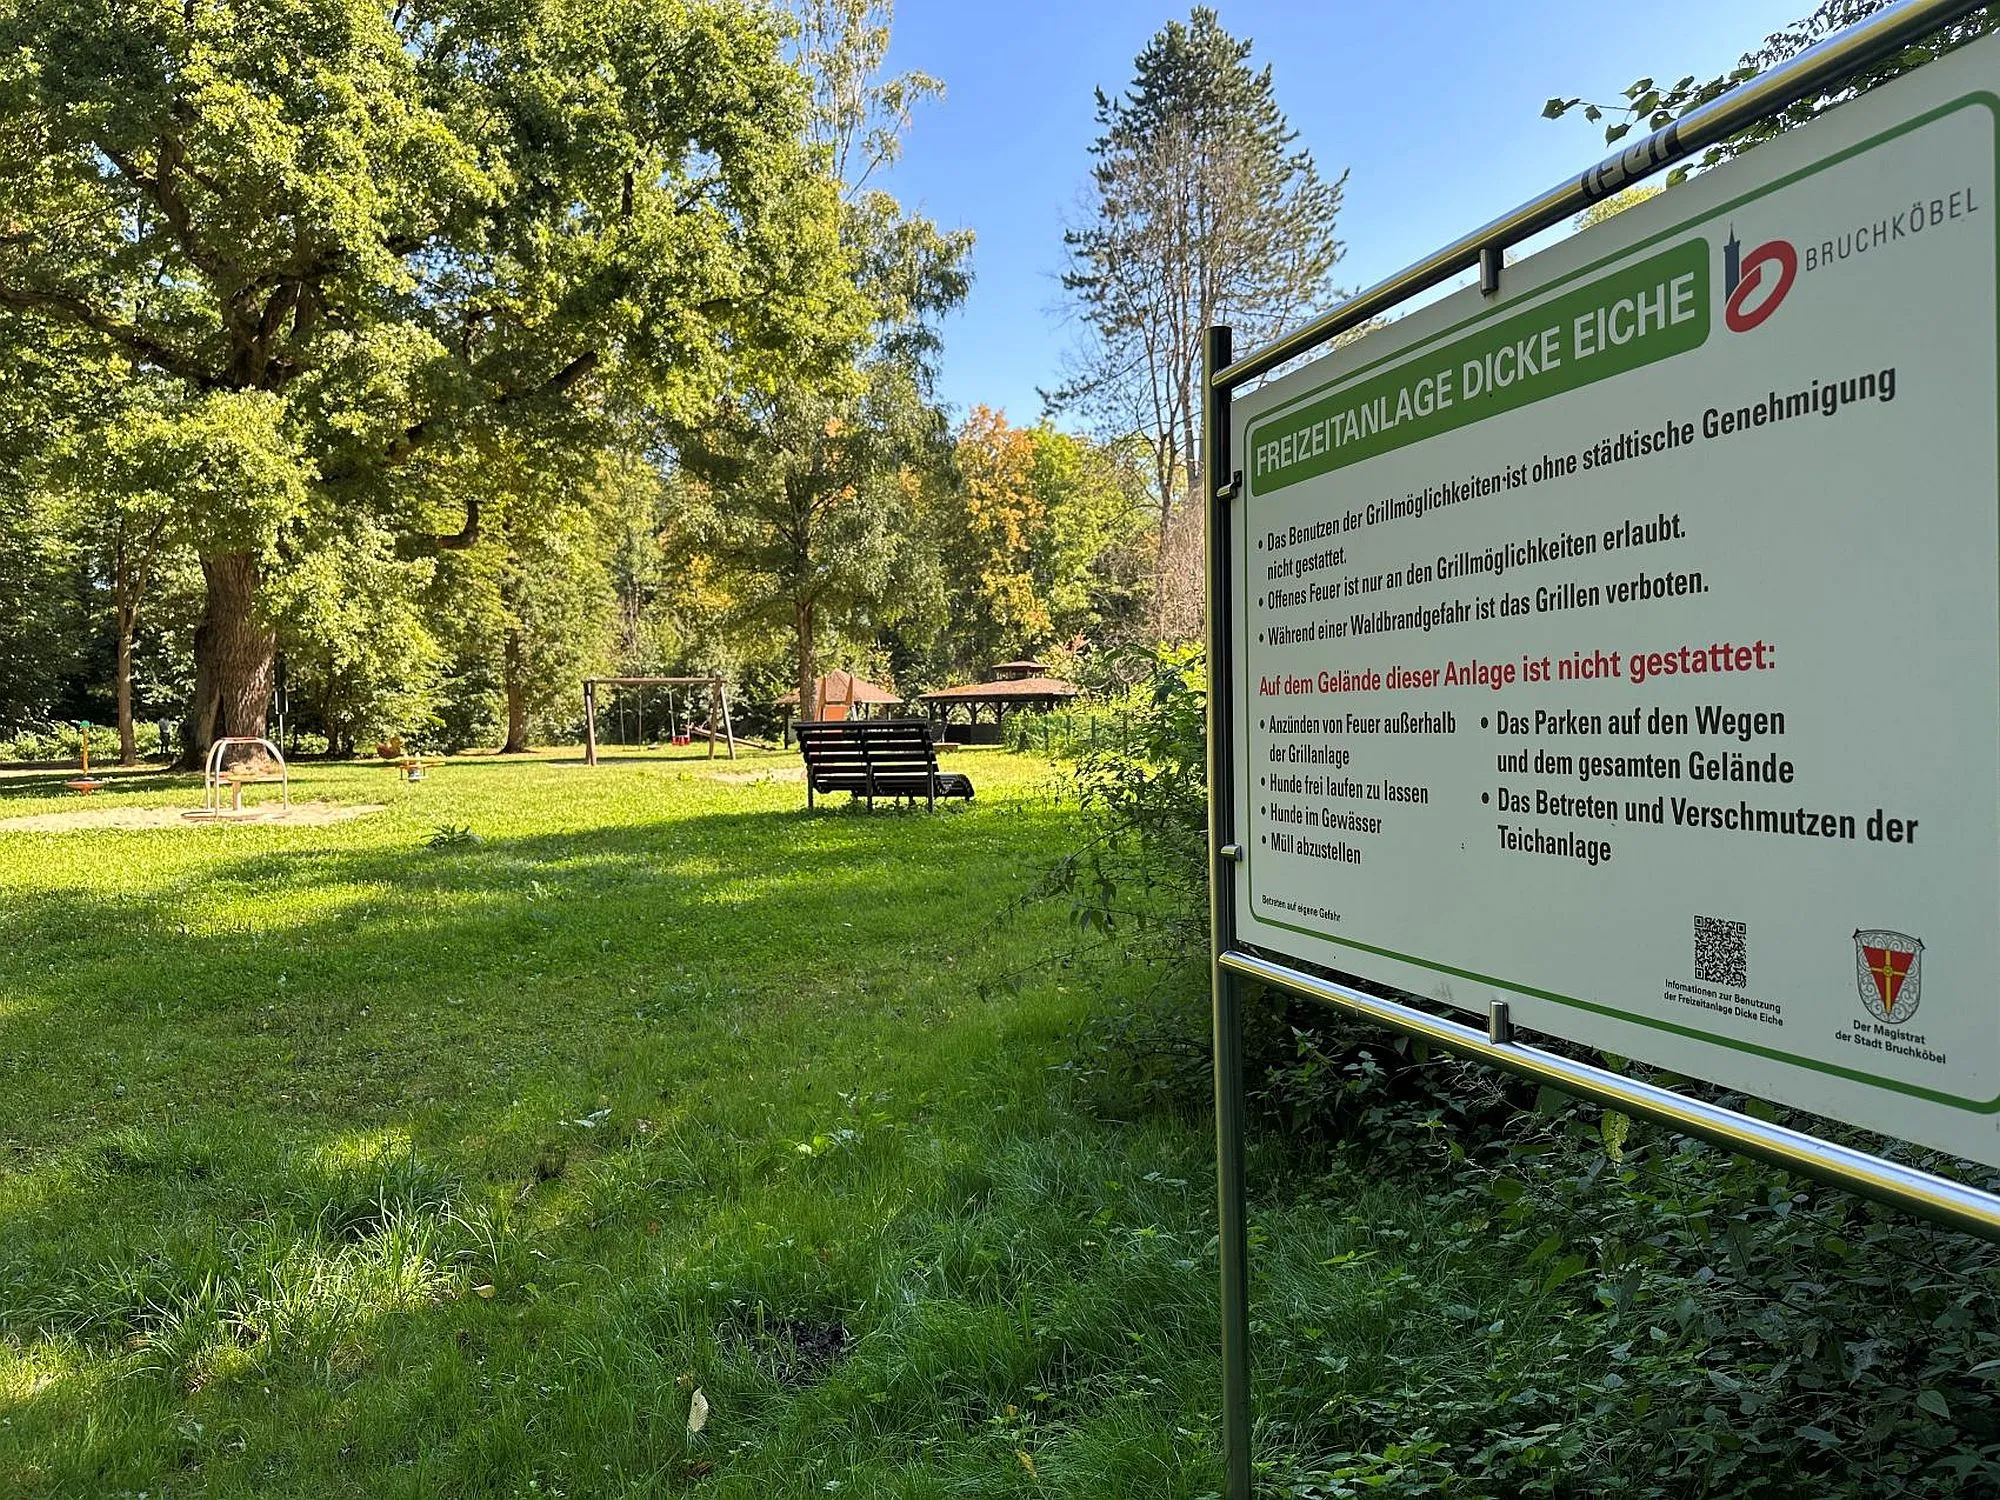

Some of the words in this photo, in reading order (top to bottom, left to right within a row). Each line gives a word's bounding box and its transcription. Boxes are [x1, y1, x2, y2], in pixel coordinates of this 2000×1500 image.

[1807, 188, 1978, 271] BRUCHKÖBEL
[1258, 369, 1452, 476] FREIZEITANLAGE
[1464, 326, 1560, 400] DICKE
[1574, 272, 1694, 359] EICHE
[1268, 533, 1286, 551] Das
[1289, 520, 1339, 546] Benutzen
[1343, 510, 1363, 532] der
[1367, 474, 1501, 526] Grillmöglichkeiten
[1505, 466, 1527, 488] ist
[1533, 455, 1577, 483] ohne
[1583, 420, 1694, 470] städtische
[1703, 368, 1895, 439] Genehmigung
[1268, 589, 1306, 609] Offenes
[1310, 583, 1340, 602] Feuer
[1344, 576, 1359, 596] ist
[1362, 575, 1383, 593] nur
[1387, 571, 1402, 588] an
[1407, 563, 1432, 585] den
[1437, 533, 1596, 579] Grillmöglichkeiten
[1603, 514, 1685, 551] erlaubt.
[1268, 558, 1293, 580] nicht
[1296, 547, 1346, 578] gestattet.
[1268, 621, 1314, 646] Während
[1318, 619, 1347, 640] einer
[1350, 600, 1471, 635] Waldbrandgefahr
[1476, 597, 1495, 620] ist
[1500, 593, 1530, 617] das
[1536, 583, 1599, 612] Grillen
[1606, 572, 1708, 604] verboten.
[1260, 675, 1280, 696] Auf
[1284, 674, 1313, 695] dem
[1318, 668, 1380, 693] Gelände
[1386, 666, 1440, 689] dieser
[1444, 659, 1515, 690] Anlage
[1523, 655, 1550, 682] ist
[1559, 650, 1621, 680] nicht
[1630, 640, 1775, 684] gestattet:
[1269, 715, 1319, 733] Anzünden
[1322, 719, 1342, 733] von
[1346, 714, 1380, 733] Feuer
[1384, 711, 1455, 733] außerhalb
[1498, 711, 1529, 734] Das
[1535, 709, 1601, 734] Parken
[1608, 707, 1641, 734] auf
[1648, 707, 1687, 734] den
[1695, 706, 1784, 742] Wegen
[1270, 744, 1286, 762] der
[1289, 744, 1349, 769] Grillanlage
[1498, 749, 1528, 773] und
[1534, 749, 1572, 774] dem
[1579, 754, 1680, 781] gesamten
[1689, 751, 1794, 783] Gelände
[1270, 773, 1302, 795] Hunde
[1305, 774, 1323, 796] frei
[1327, 776, 1363, 798] laufen
[1367, 785, 1380, 800] zu
[1384, 780, 1428, 804] lassen
[1271, 803, 1302, 824] Hunde
[1306, 806, 1318, 826] im
[1322, 808, 1381, 833] Gewässer
[1499, 787, 1530, 813] Das
[1536, 789, 1617, 821] Betreten
[1625, 796, 1664, 824] und
[1671, 797, 1855, 839] Verschmutzen
[1867, 809, 1918, 844] der
[1271, 832, 1294, 853] Müll
[1298, 836, 1360, 864] abzustellen
[1498, 825, 1611, 866] Teichanlage
[1664, 991, 1676, 1001] der
[1678, 994, 1732, 1015] Freizeitanlage
[1735, 1007, 1757, 1020] Dicke
[1760, 1012, 1783, 1026] Eiche
[1719, 993, 1732, 1001] zur
[1735, 994, 1780, 1014] Benutzung
[1835, 1030, 1852, 1042] der
[1854, 1034, 1882, 1049] Stadt
[1885, 1041, 1946, 1064] Bruchköbel
[1854, 1020, 1871, 1036] Der
[1874, 1024, 1925, 1045] Magistrat
